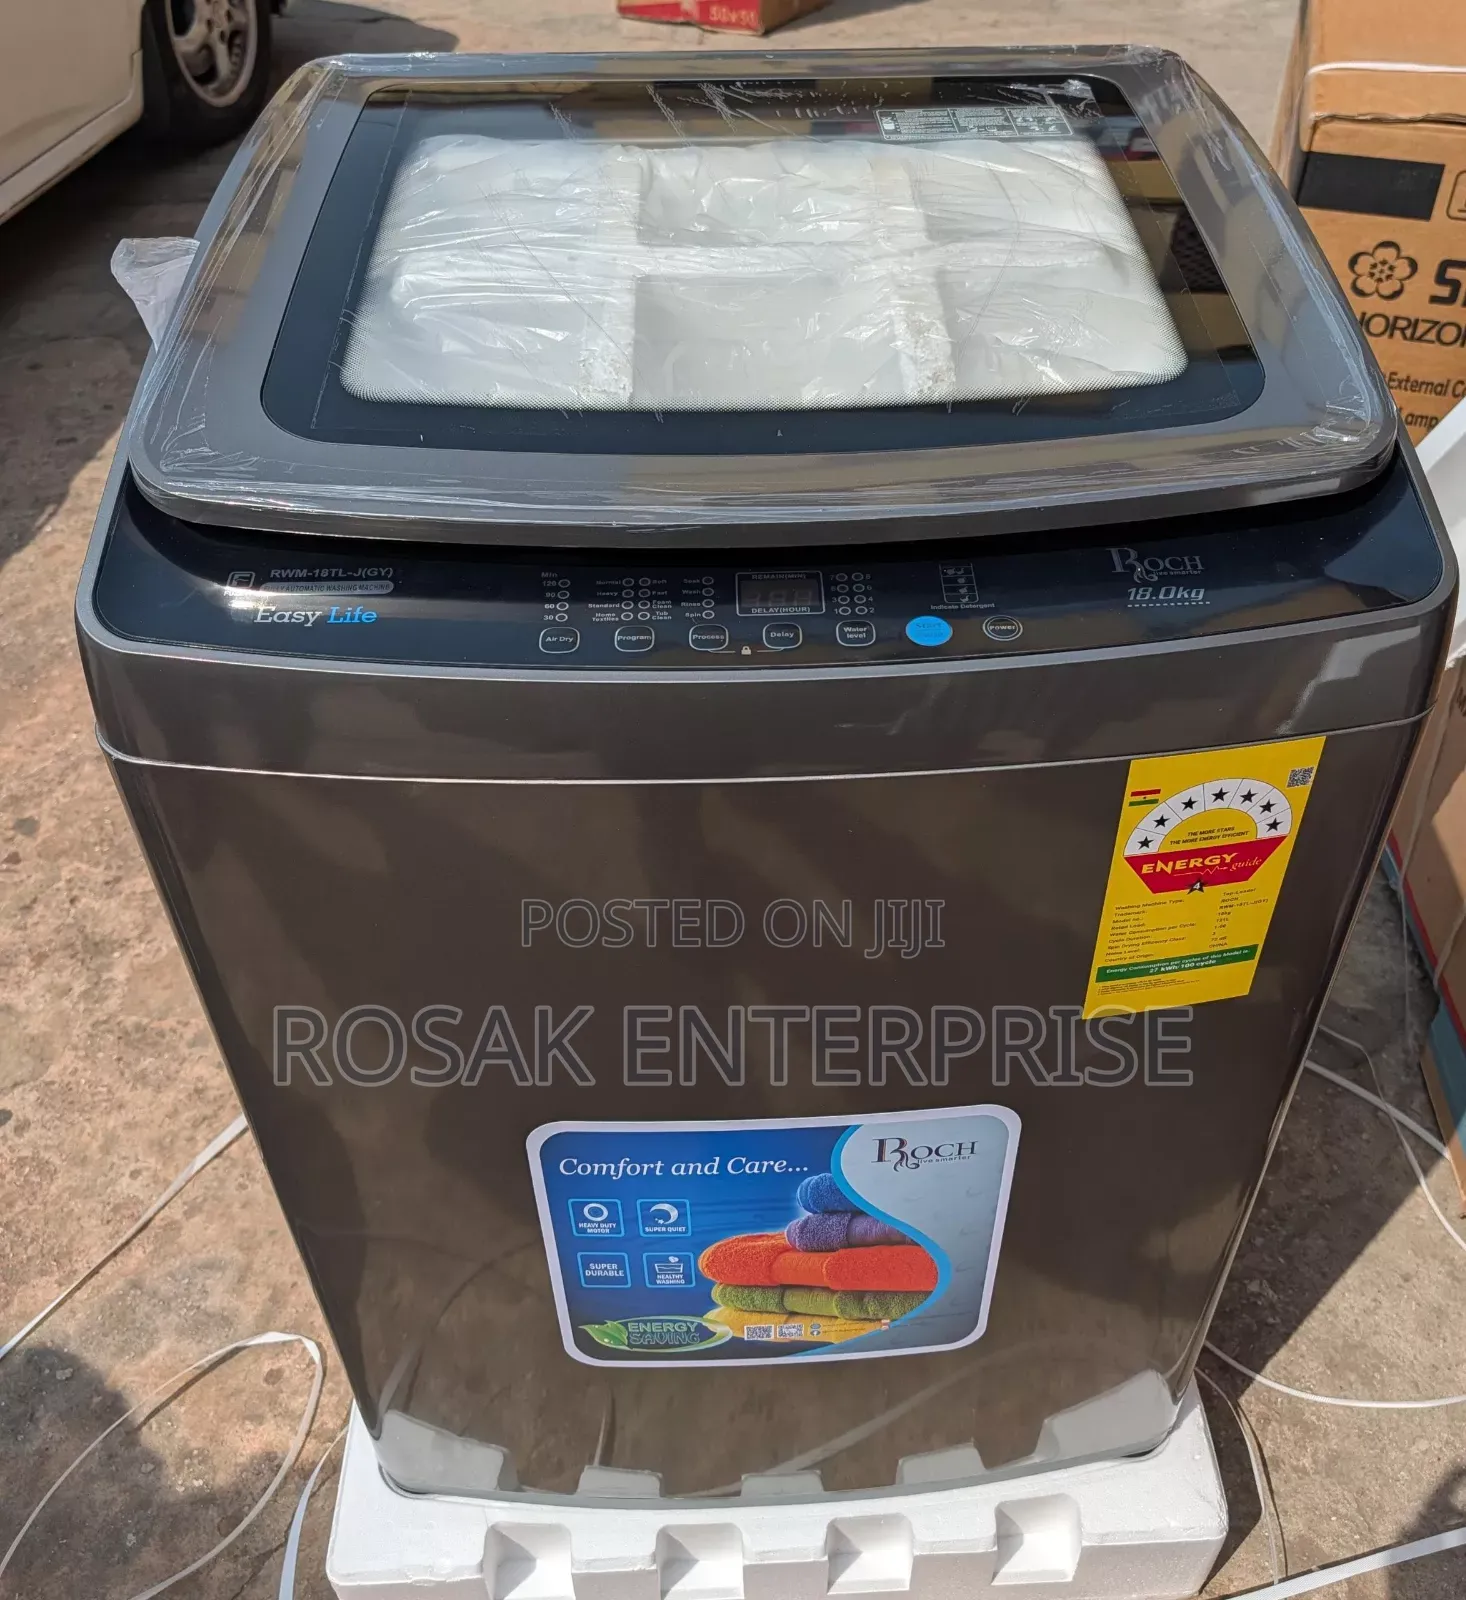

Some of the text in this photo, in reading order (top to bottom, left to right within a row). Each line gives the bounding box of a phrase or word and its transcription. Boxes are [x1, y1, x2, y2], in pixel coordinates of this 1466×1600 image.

[1428, 259, 1466, 305] S
[1359, 311, 1466, 347] ORIZO
[1387, 371, 1449, 396] External
[1105, 547, 1205, 583] ROCH
[270, 567, 393, 578] RWM-18TL-J(GY)
[285, 584, 325, 592] AUTOMATIC
[326, 583, 358, 591] WASHING
[358, 583, 390, 591] MACHINE
[1127, 586, 1205, 601] 18.0kg
[254, 605, 378, 627] Easy Life
[751, 606, 811, 614] DELAY(HOUR)
[617, 634, 652, 642] Program
[770, 631, 794, 639] Delay
[1216, 826, 1235, 834] STARS
[1181, 837, 1198, 845] MORE
[1198, 835, 1221, 843] ENERGY
[1221, 831, 1250, 841] EFFICIENT
[1141, 852, 1263, 875] ENERGY guide
[1193, 882, 1201, 891] 4
[1128, 961, 1170, 971] Consumption
[1170, 959, 1181, 967] per
[1223, 950, 1243, 958] Model
[1196, 959, 1217, 967] cycle
[871, 1137, 979, 1172] ROCH
[935, 1155, 972, 1163] smarter
[559, 1156, 809, 1180] Comfort and Care...
[585, 1269, 625, 1277] DURABLE
[627, 1321, 698, 1333] ENERGY
[627, 1332, 700, 1345] SAVING
